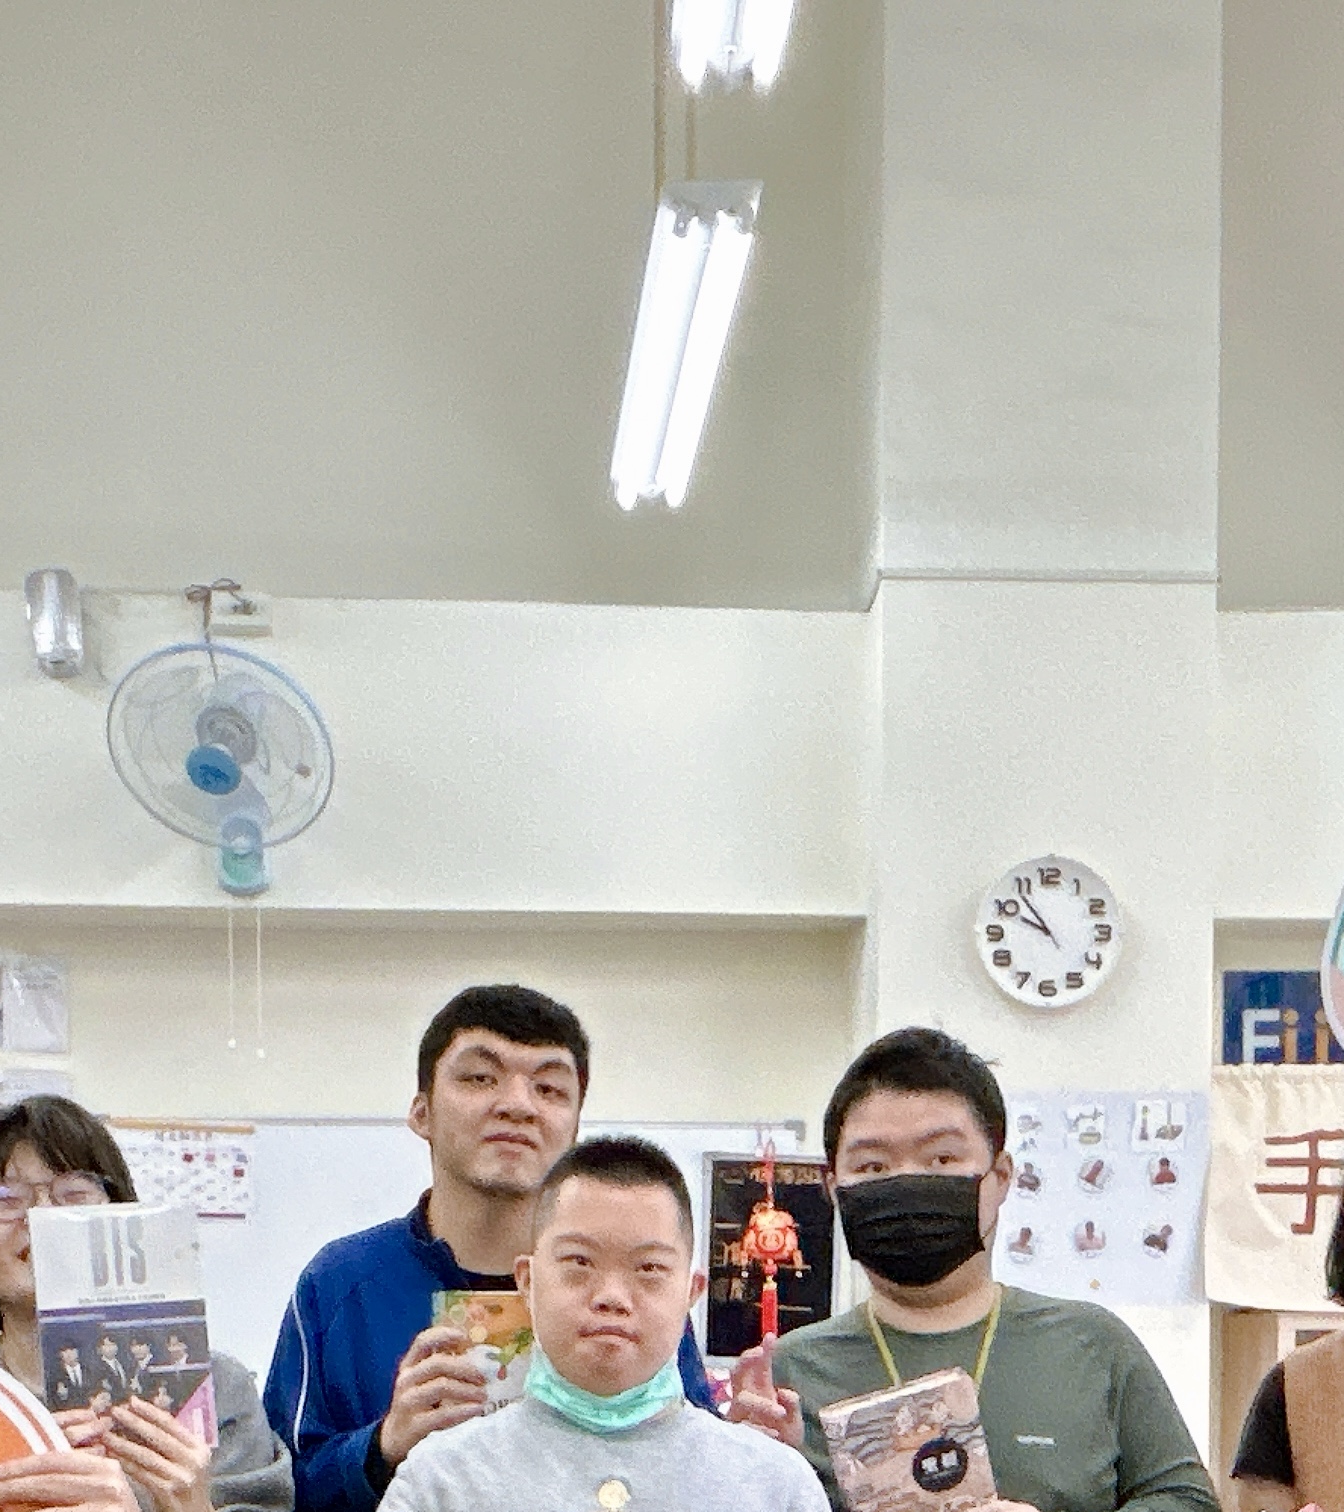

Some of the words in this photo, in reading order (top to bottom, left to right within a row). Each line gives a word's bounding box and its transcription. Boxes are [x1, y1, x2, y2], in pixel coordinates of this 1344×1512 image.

[1037, 867, 1061, 885] 12
[1015, 877, 1031, 895] 11
[1089, 898, 1106, 915] 2
[986, 924, 1004, 942] 9
[1094, 924, 1112, 942] 3
[993, 950, 1011, 967] 8
[1016, 971, 1031, 989] 7
[1038, 980, 1057, 997] 6
[1066, 972, 1084, 989] 5
